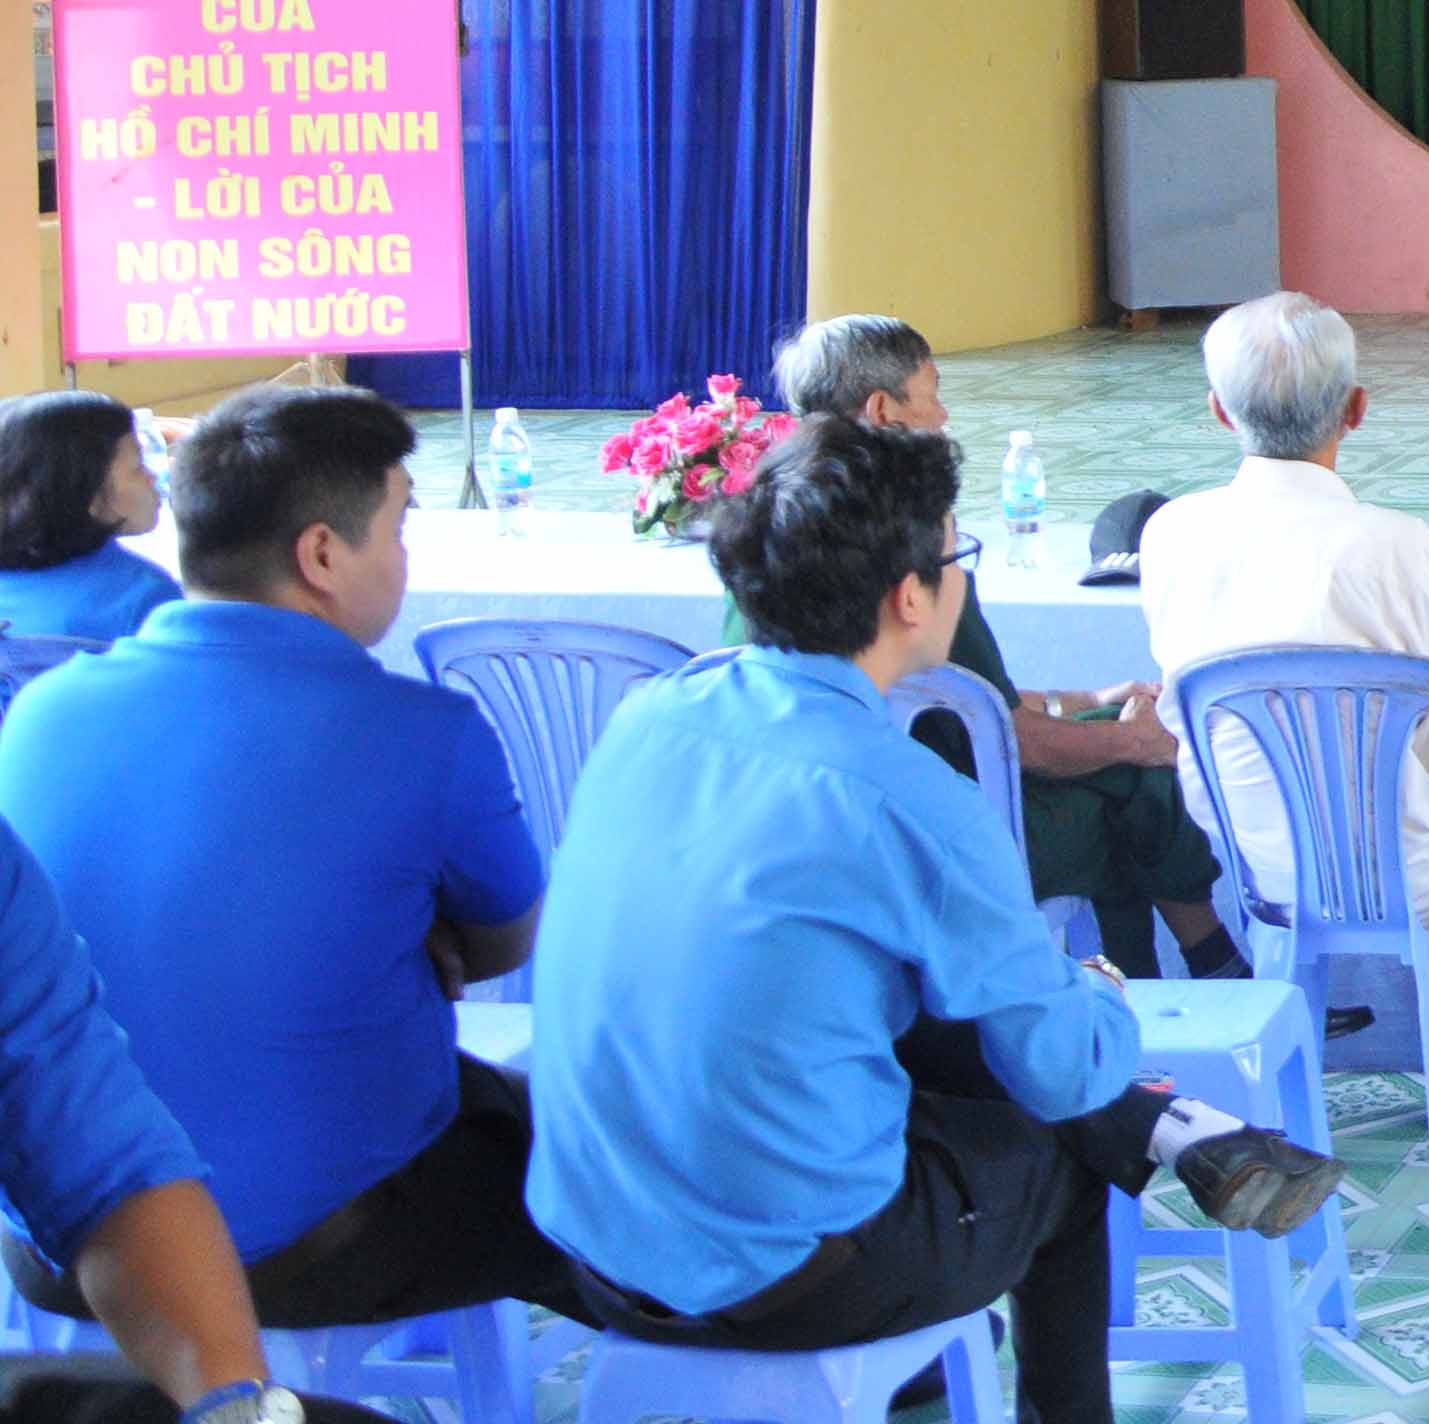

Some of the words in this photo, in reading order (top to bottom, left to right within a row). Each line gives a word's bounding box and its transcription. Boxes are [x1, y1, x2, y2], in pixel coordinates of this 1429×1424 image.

[129, 41, 243, 96] CHỦ
[262, 51, 386, 101] TỊCH
[80, 106, 155, 161] HỒ
[177, 107, 269, 157] CHÍ
[291, 112, 438, 154] MINH
[175, 168, 260, 220] LỜI
[281, 161, 393, 216] CỦA
[117, 240, 239, 284] NON
[258, 228, 411, 279] SÔNG
[125, 286, 235, 345] ĐẤT
[251, 288, 405, 345] NƯỚC
